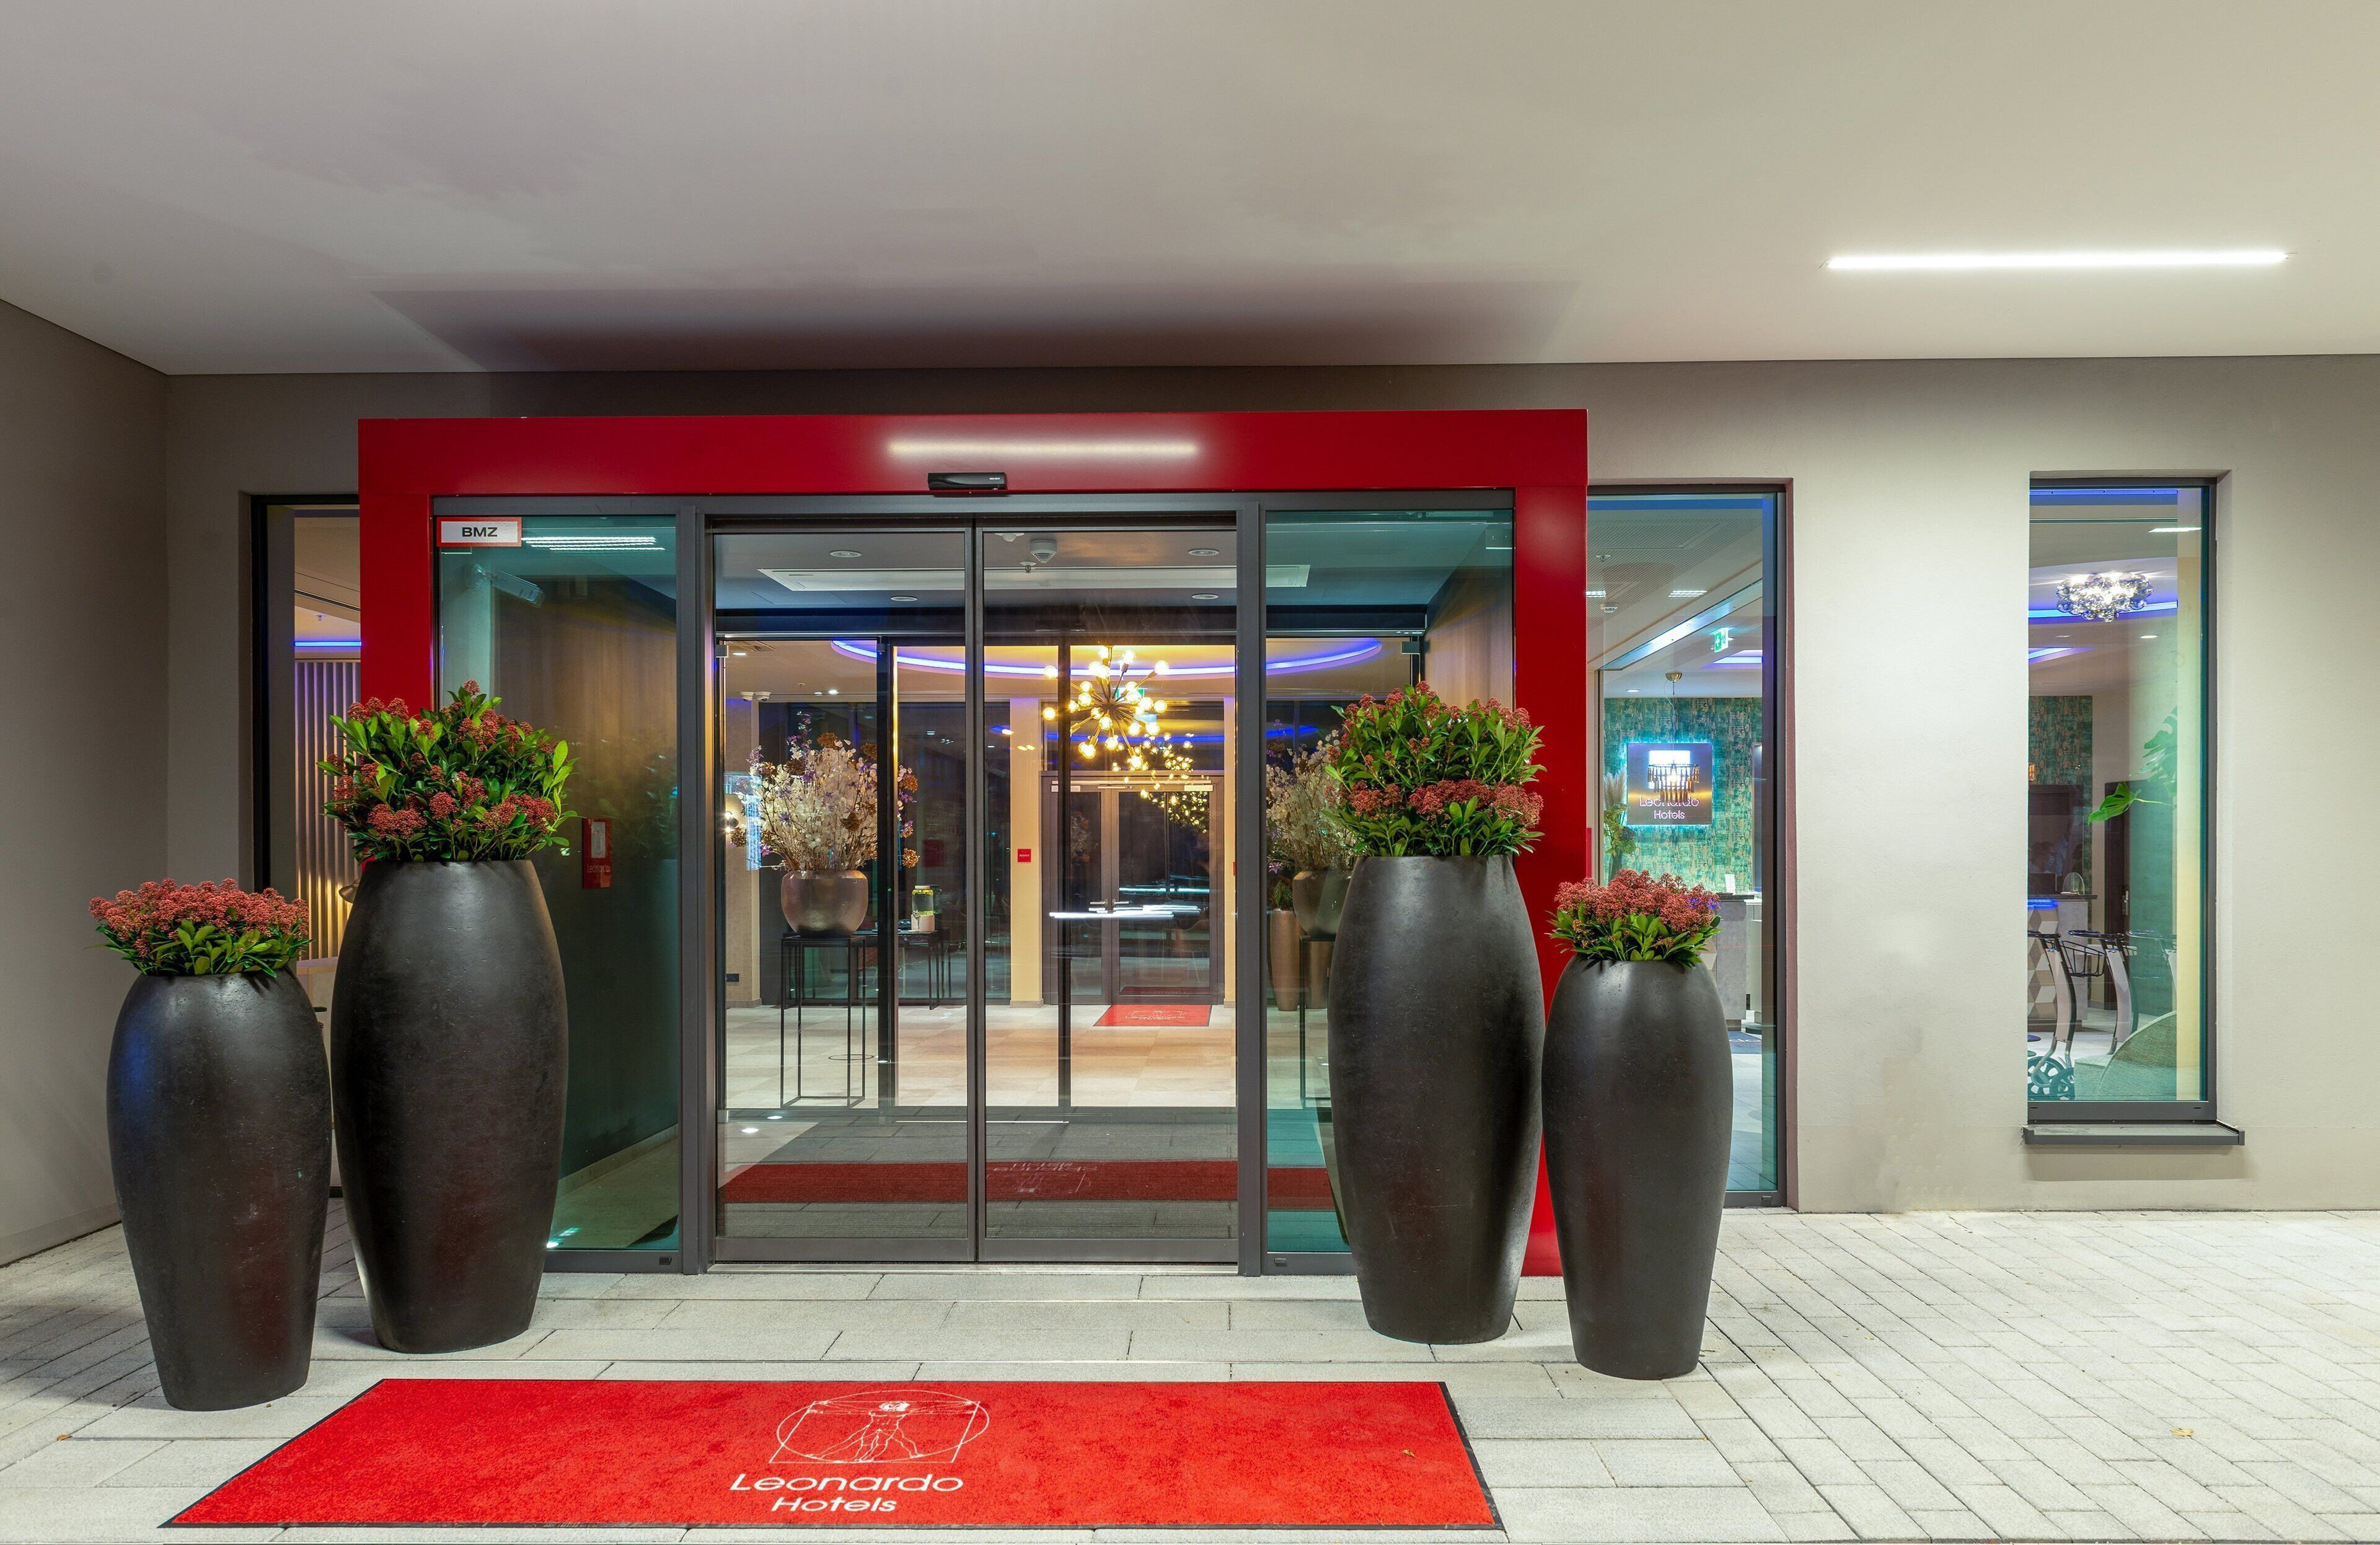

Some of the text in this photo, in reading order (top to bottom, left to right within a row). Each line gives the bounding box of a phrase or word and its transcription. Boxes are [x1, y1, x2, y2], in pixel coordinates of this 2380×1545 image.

[462, 527, 498, 537] BMZ
[1654, 810, 1685, 819] Hotels
[730, 1474, 964, 1492] Leonardo
[771, 1497, 897, 1512] Hotels
